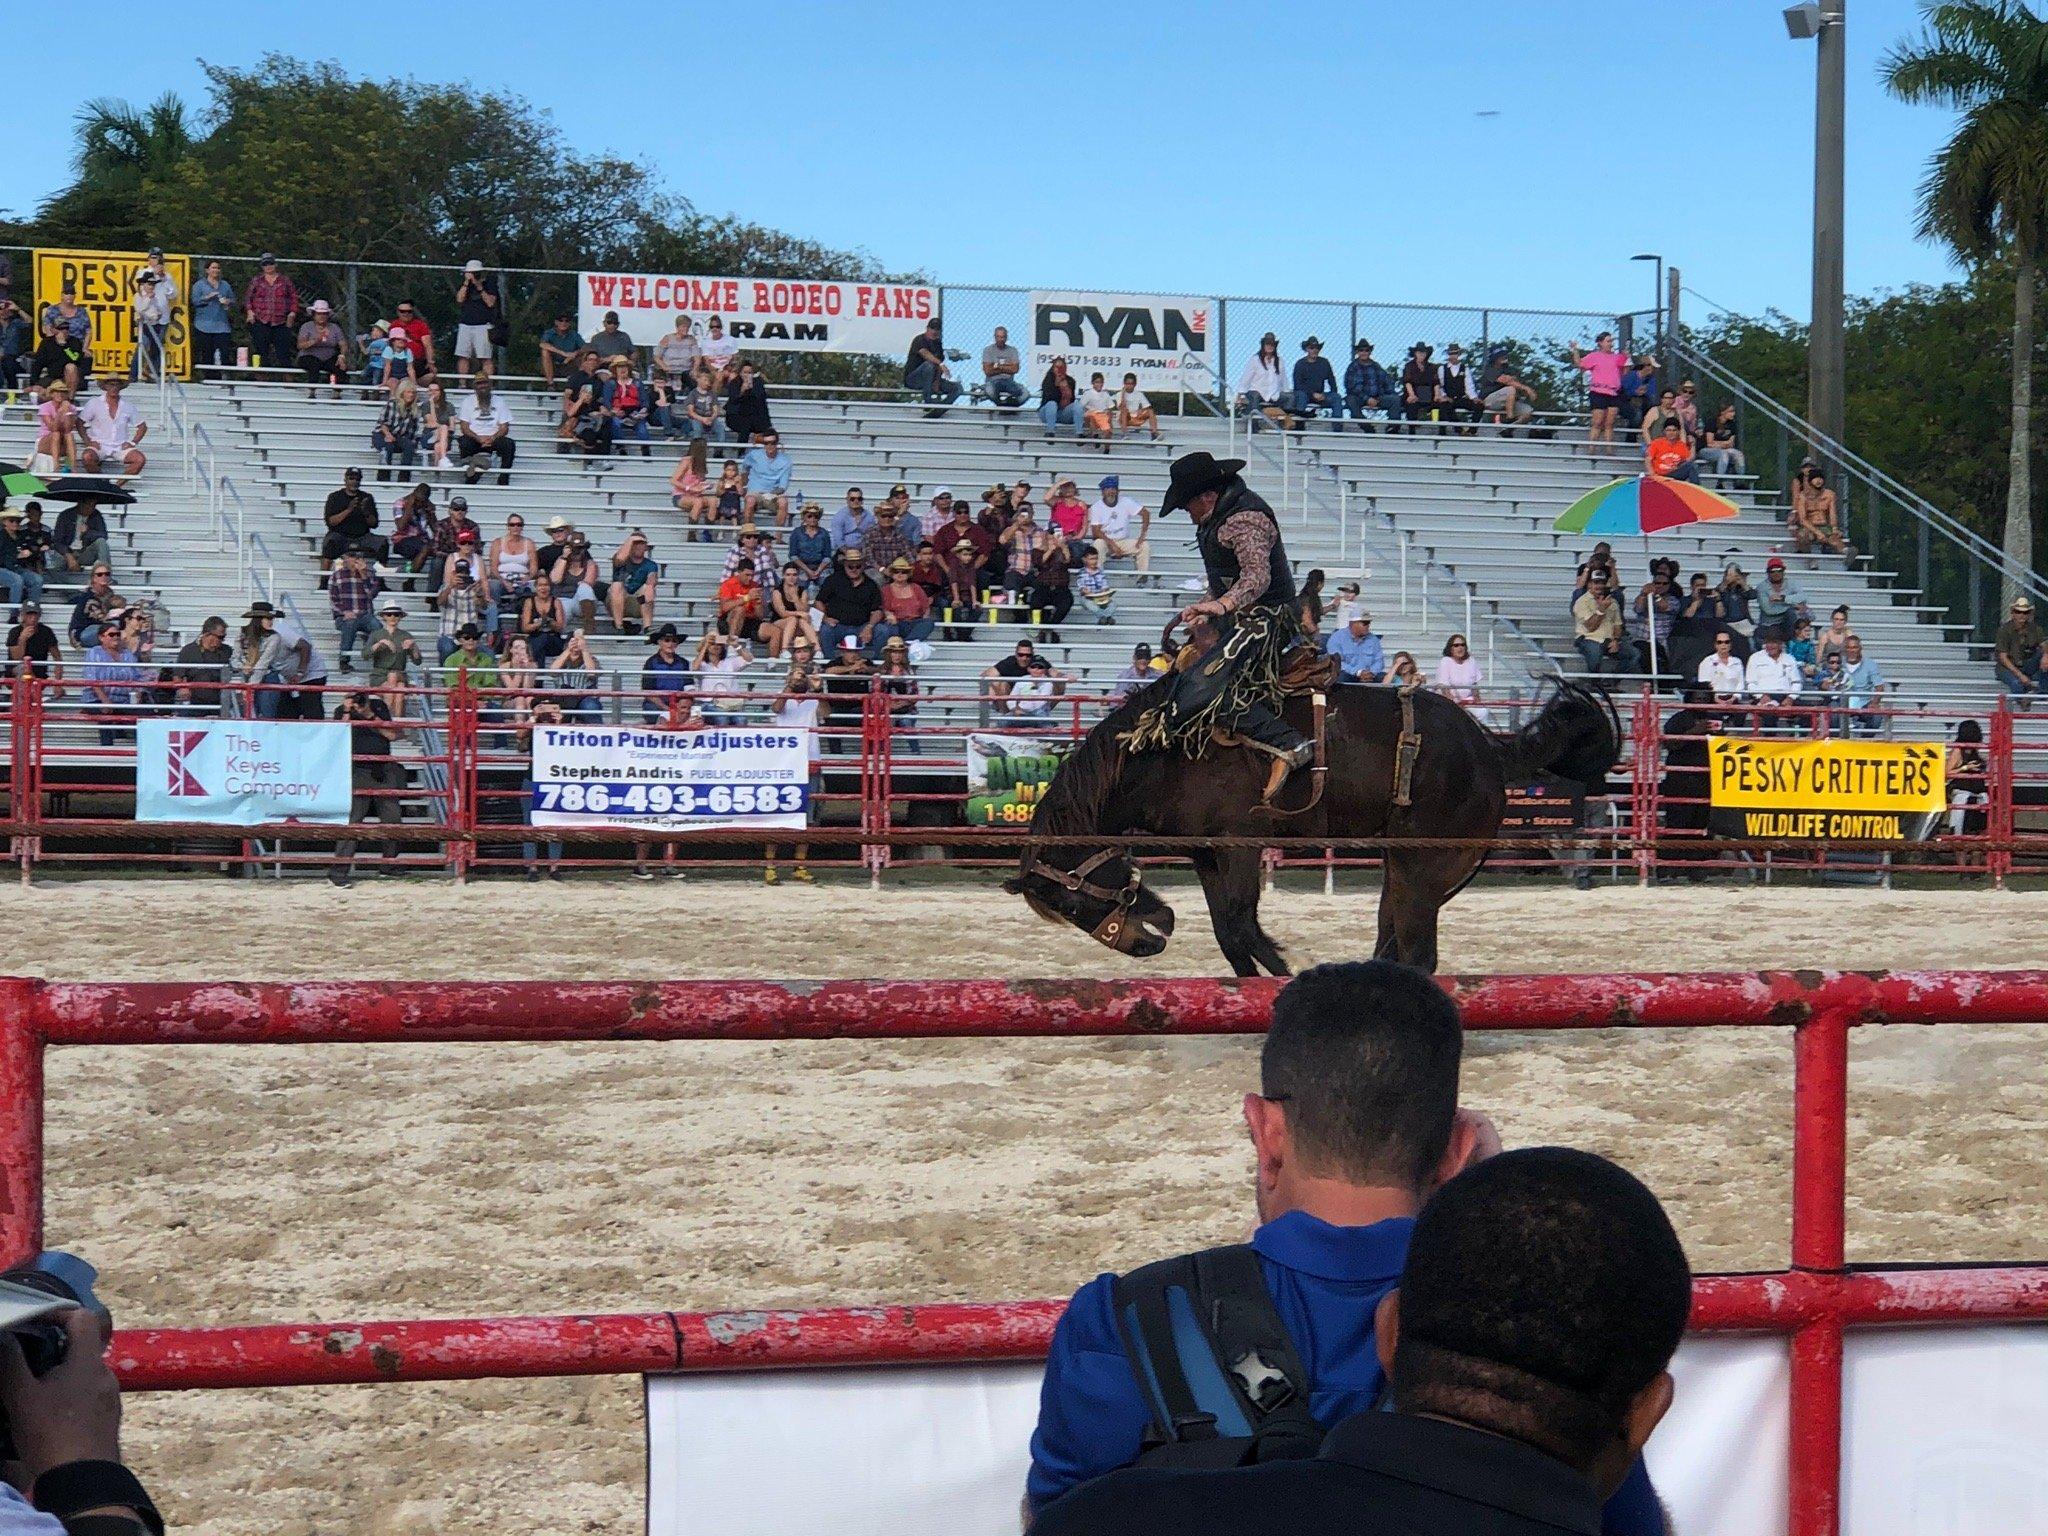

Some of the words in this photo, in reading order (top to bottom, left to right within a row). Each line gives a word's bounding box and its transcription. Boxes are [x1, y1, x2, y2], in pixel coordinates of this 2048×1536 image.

[61, 262, 149, 303] PESK
[587, 275, 739, 313] WELCOME
[753, 282, 841, 317] RODEO
[856, 286, 931, 320] FANS
[730, 321, 828, 341] RAM
[1035, 303, 1206, 352] RYAN
[1193, 309, 1206, 333] INC
[1037, 353, 1121, 367] (95)571-8833
[225, 734, 261, 753] The
[545, 730, 613, 747] Triton
[618, 731, 688, 749] Public
[692, 732, 798, 752] Adjusters
[225, 755, 281, 779] Keyes
[549, 765, 622, 780] Stephen
[626, 766, 683, 779] Andris
[690, 769, 732, 779] PUBLIC
[735, 769, 795, 779] ADJUSTER
[1721, 755, 1804, 792] PESKY
[1811, 757, 1931, 796] CRITTERS
[224, 777, 321, 801] Company
[538, 784, 803, 813] 786-493-6583
[1745, 812, 1826, 838] WILDLIFE
[1829, 814, 1905, 840] CONTROL
